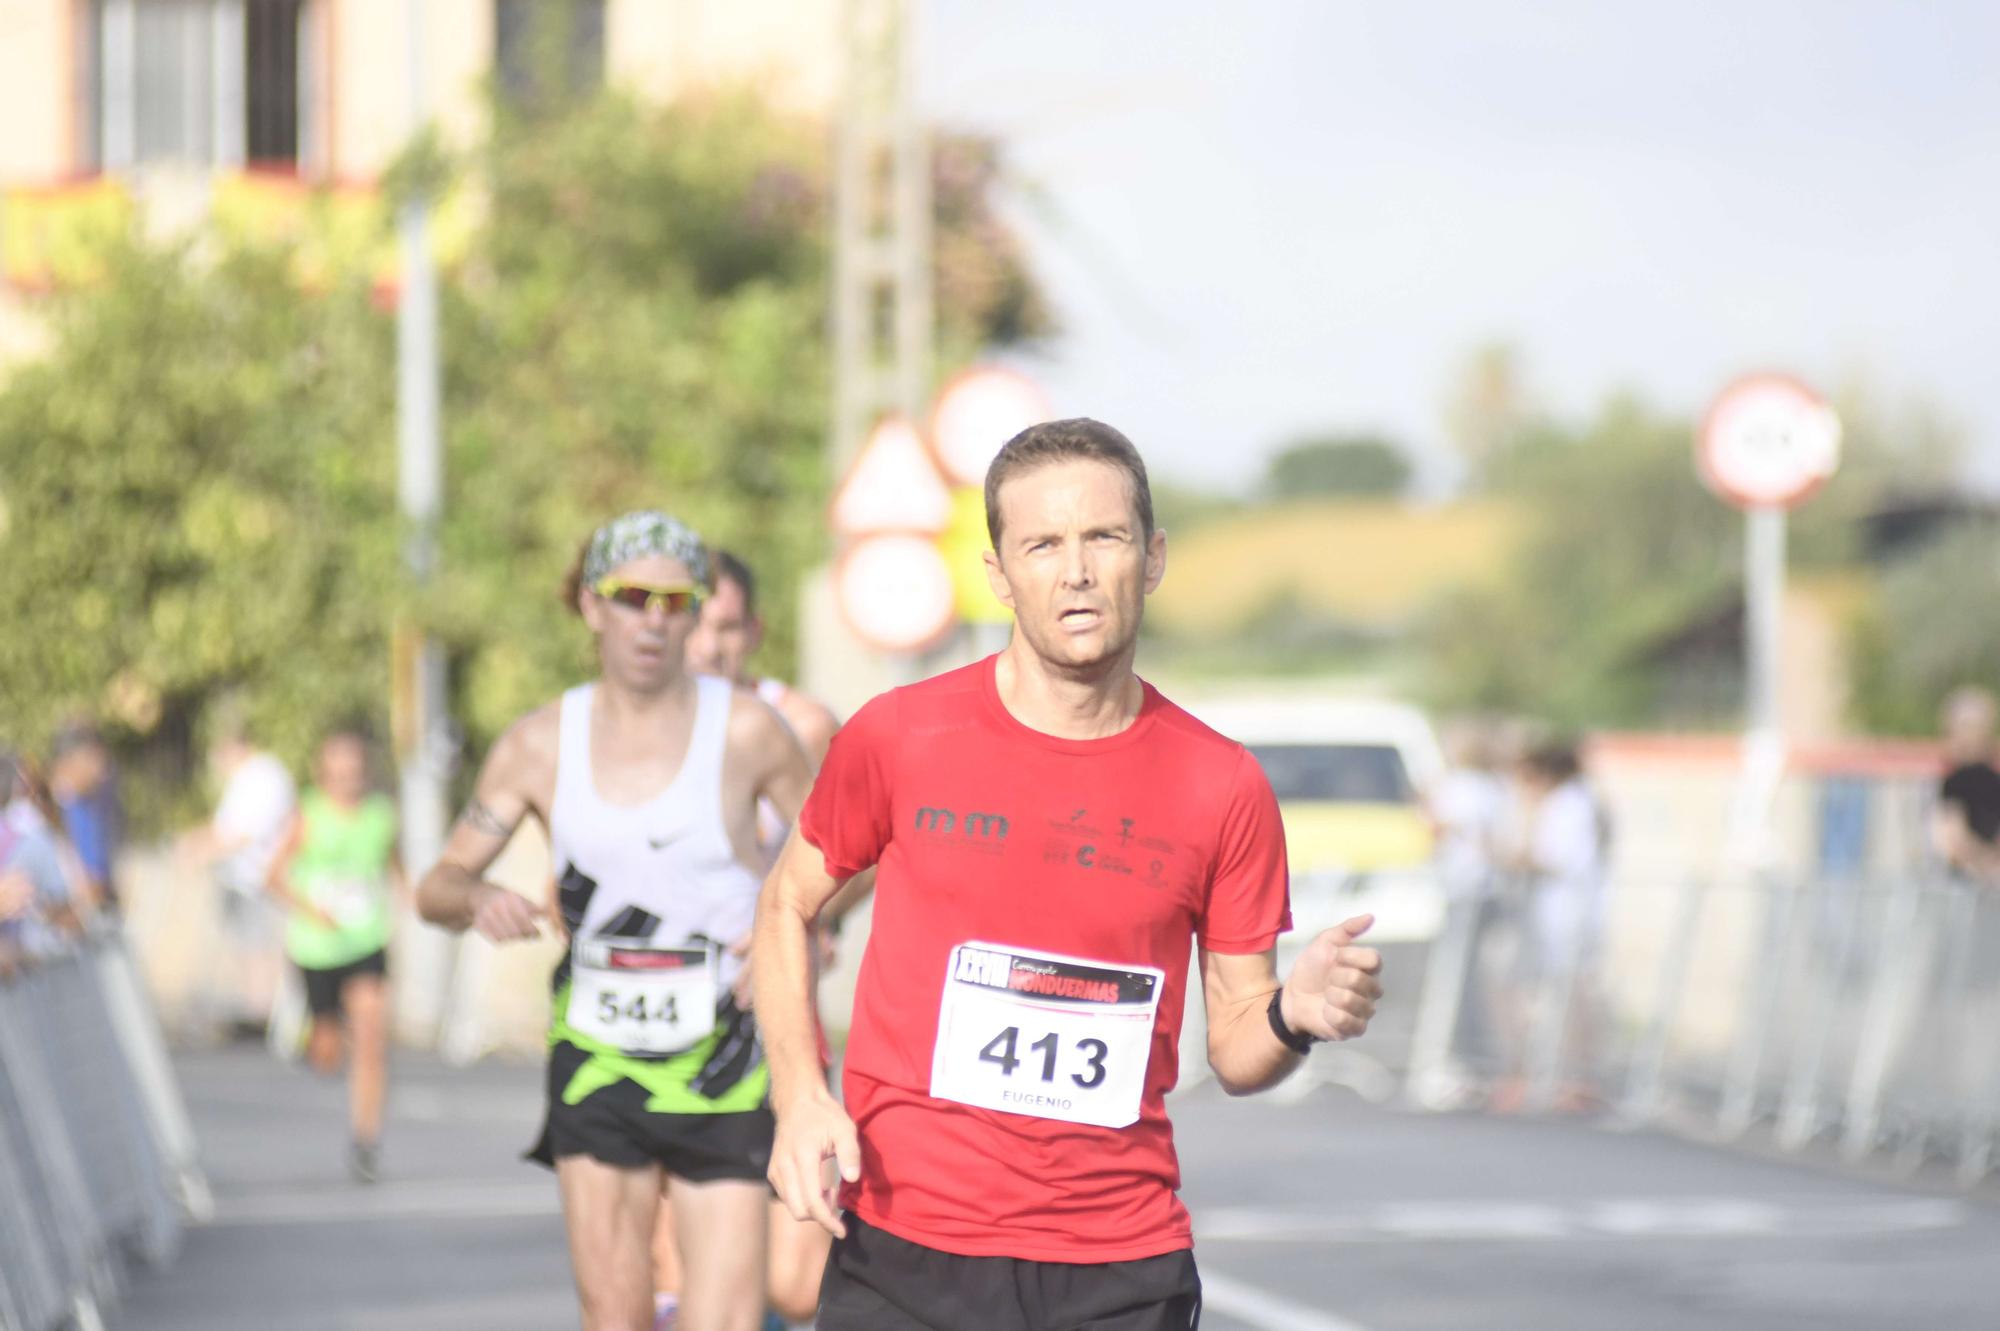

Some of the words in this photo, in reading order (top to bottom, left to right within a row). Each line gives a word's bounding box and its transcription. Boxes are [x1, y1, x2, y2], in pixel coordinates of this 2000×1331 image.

[597, 992, 678, 1024] 544
[978, 1026, 1109, 1091] 413
[1002, 1090, 1073, 1111] EUGENIO
